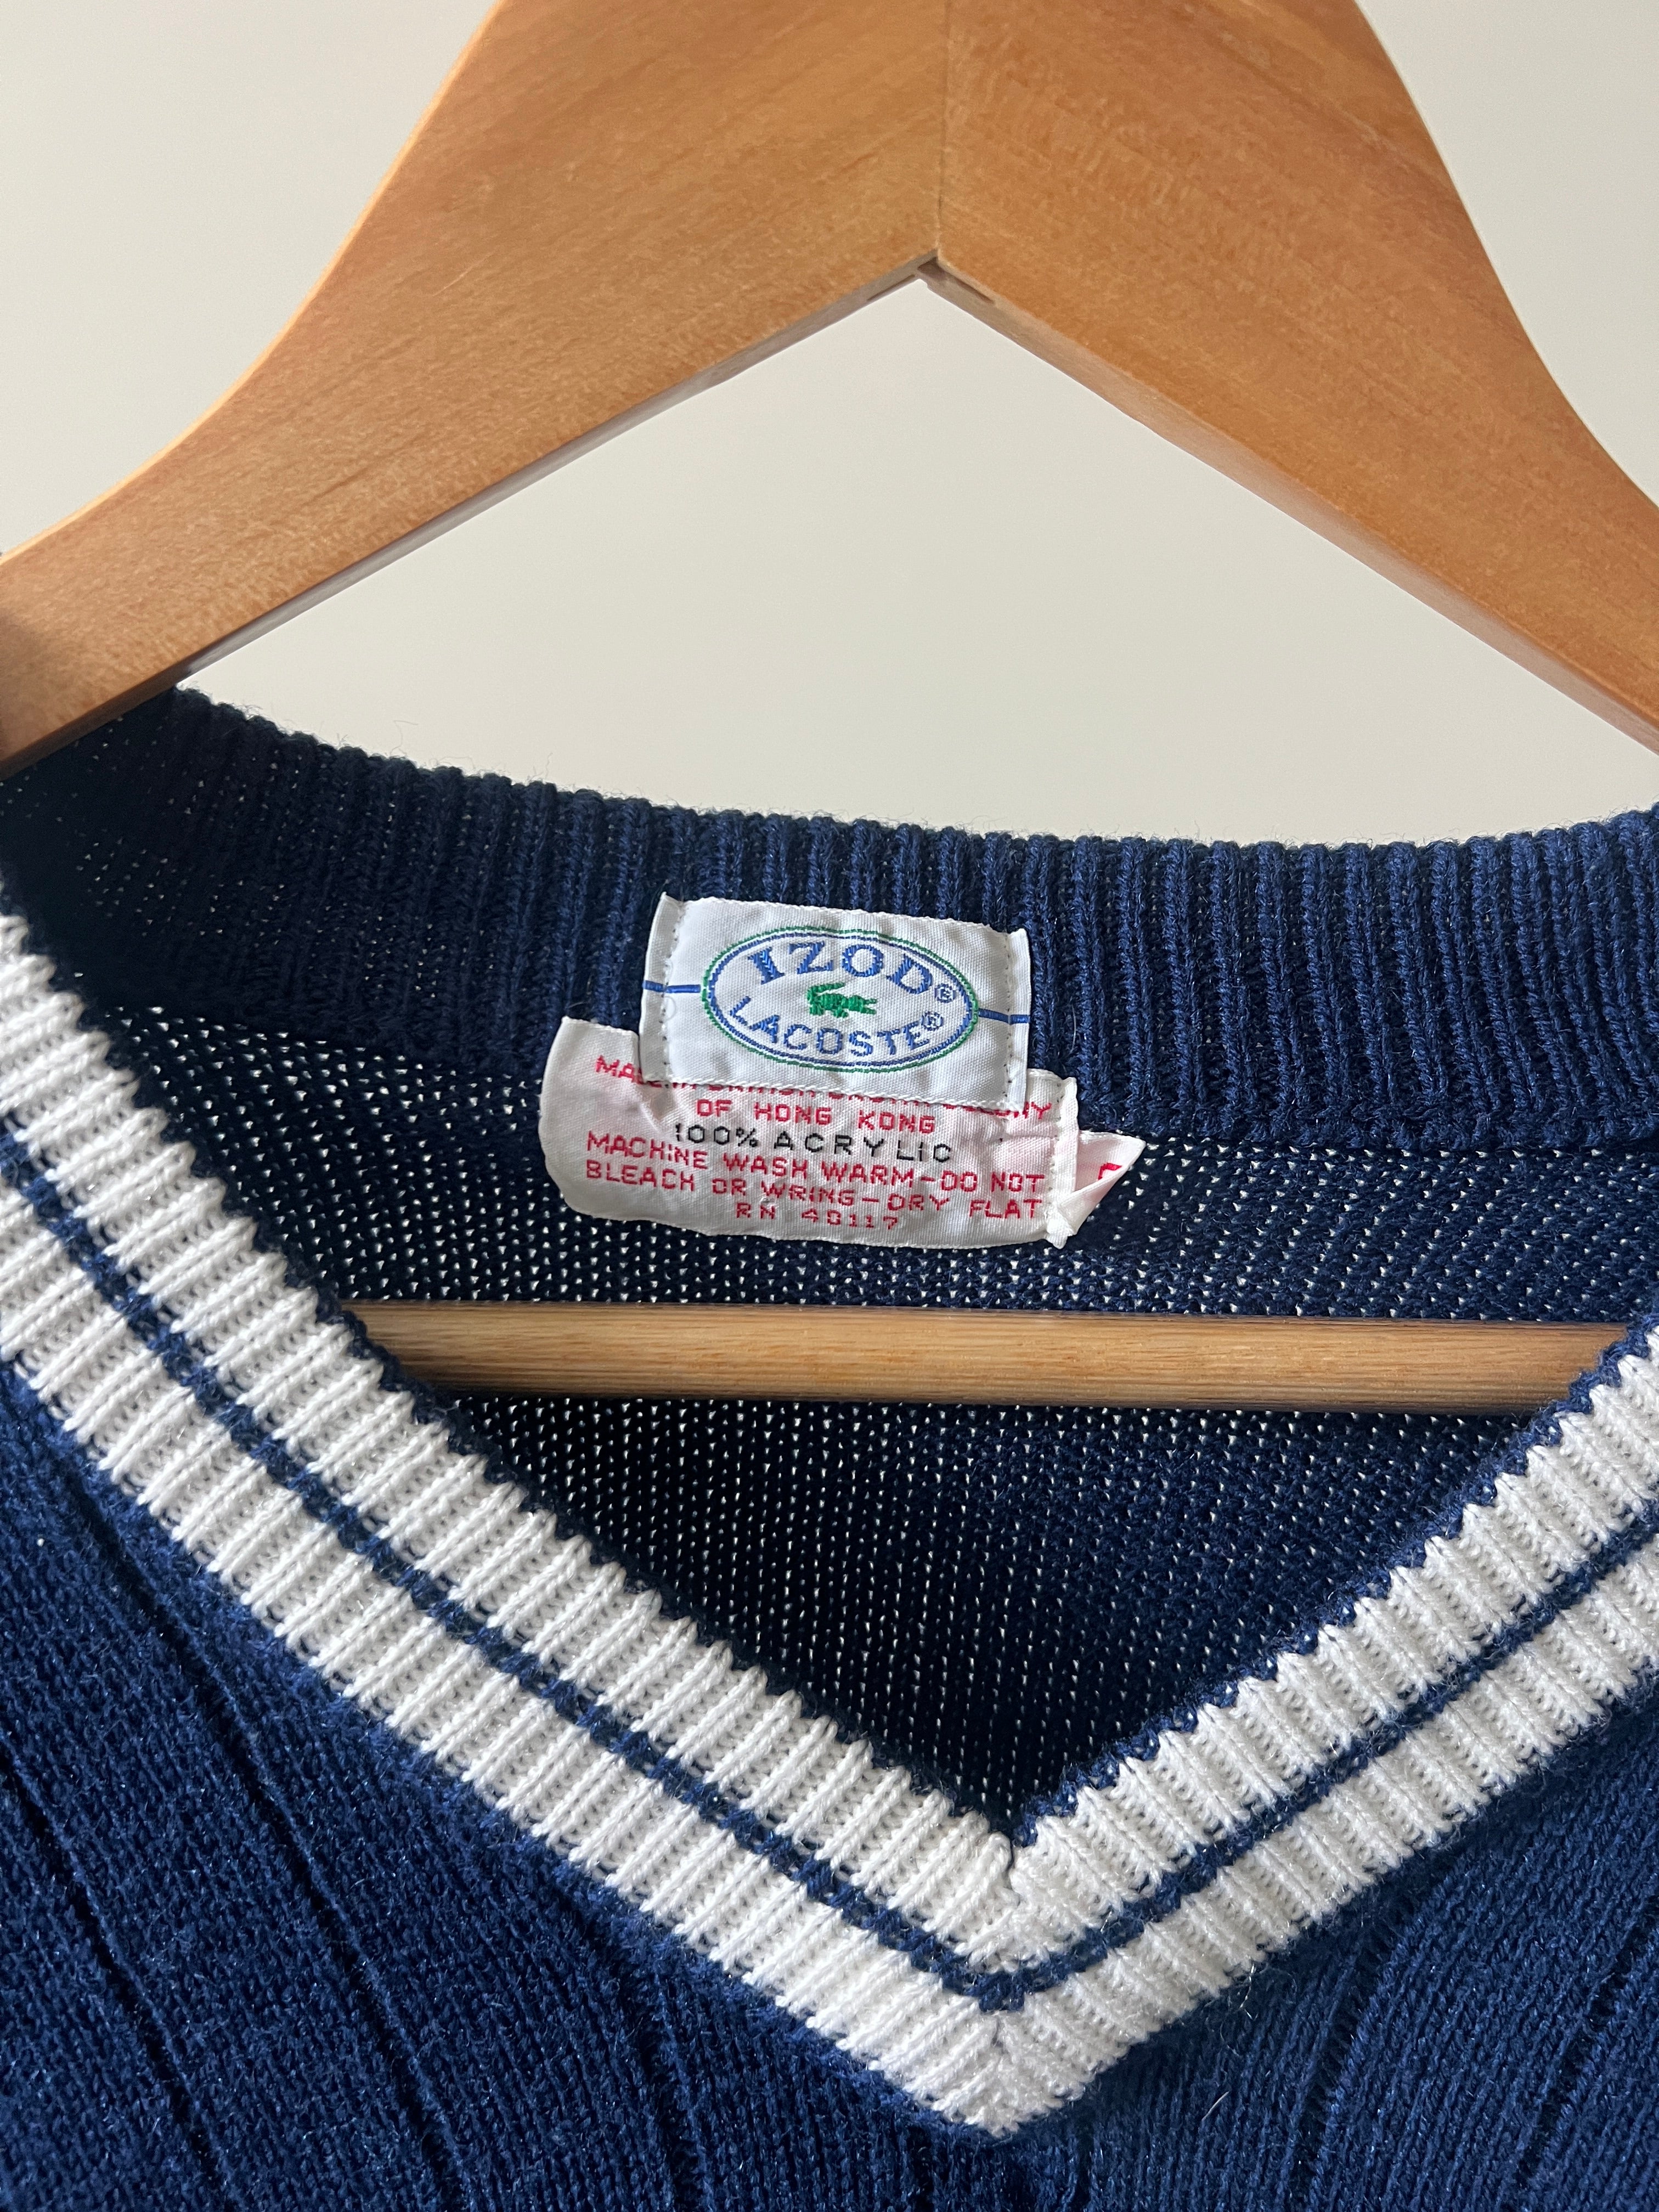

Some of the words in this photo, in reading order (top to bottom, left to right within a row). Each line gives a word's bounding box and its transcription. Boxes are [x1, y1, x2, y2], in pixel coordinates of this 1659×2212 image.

[696, 1098, 732, 1118] OF
[753, 1101, 832, 1126] HONG
[857, 1109, 936, 1134] KONG
[587, 1130, 708, 1170] MACHINE
[723, 1152, 808, 1180] WASH
[991, 1171, 1045, 1193] NOT
[674, 1122, 760, 1148] 100%
[774, 1130, 951, 1163] ACRYLIC
[586, 1158, 695, 1192] BLEACH
[712, 1177, 747, 1197] OR
[968, 1198, 1043, 1219] FLAT
[737, 1201, 776, 1220] RN
[800, 1208, 899, 1230] 40117
